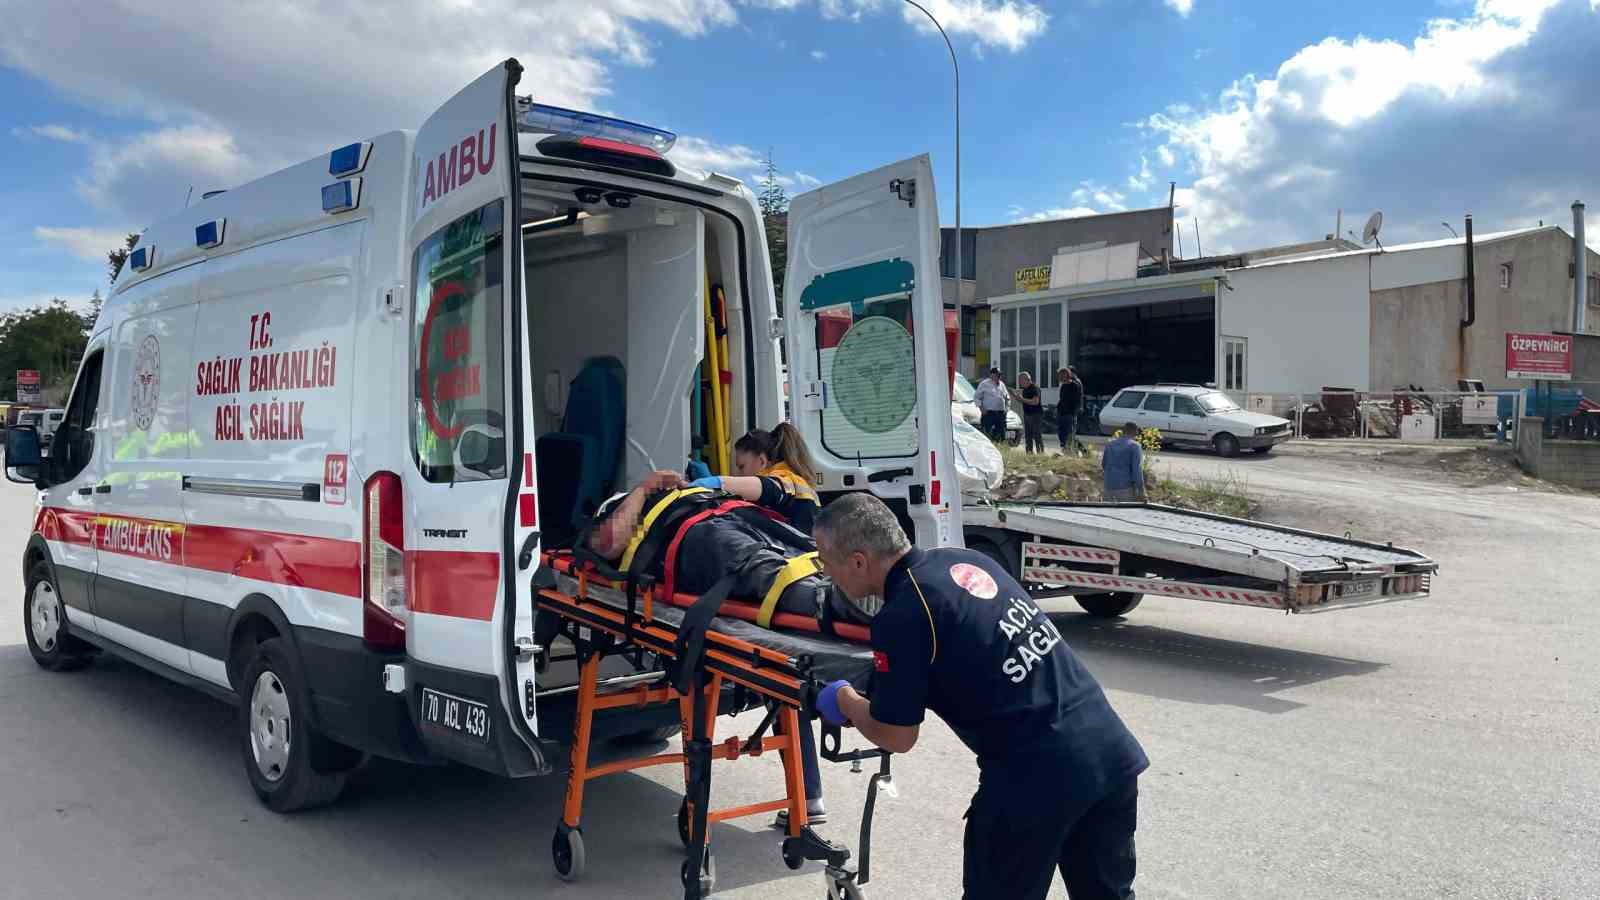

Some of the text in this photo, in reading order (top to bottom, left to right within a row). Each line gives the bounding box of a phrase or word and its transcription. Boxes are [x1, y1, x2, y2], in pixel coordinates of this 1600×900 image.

[422, 123, 497, 209] AMBU
[249, 311, 273, 351] T.C.
[196, 338, 337, 396] SAĞLIK BAKANLIĞI
[215, 396, 304, 441] ACİL SAĞLIK
[327, 460, 344, 484] 112
[103, 519, 172, 560] AMBULANS
[423, 528, 468, 538] TRANSIT
[998, 597, 1039, 641] ACİL
[1002, 618, 1062, 683] SAĞLI
[427, 694, 486, 737] 70 ACL 433
